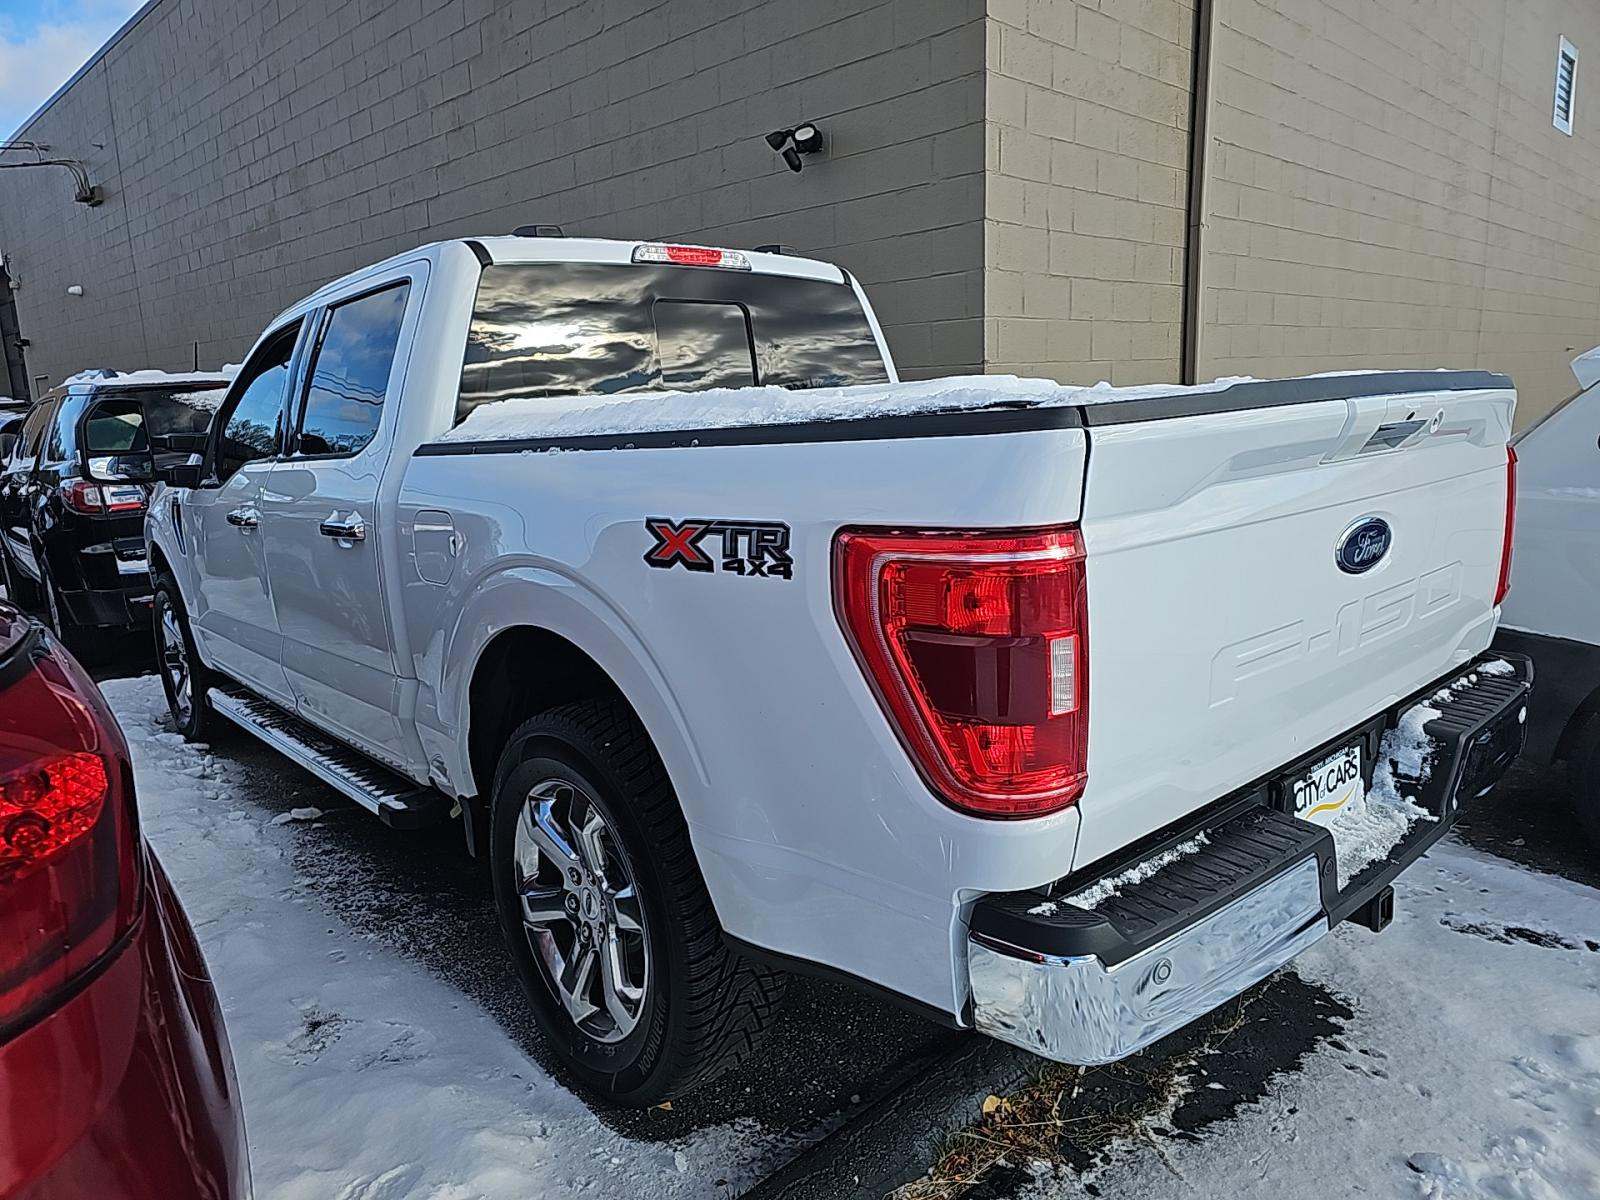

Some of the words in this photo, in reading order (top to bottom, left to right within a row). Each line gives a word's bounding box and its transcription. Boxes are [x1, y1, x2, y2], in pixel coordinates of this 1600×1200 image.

[722, 558, 794, 581] 4x4
[1354, 530, 1386, 563] Ford
[1208, 559, 1463, 709] F-150
[1295, 775, 1323, 813] CITY
[1326, 754, 1358, 793] CARS
